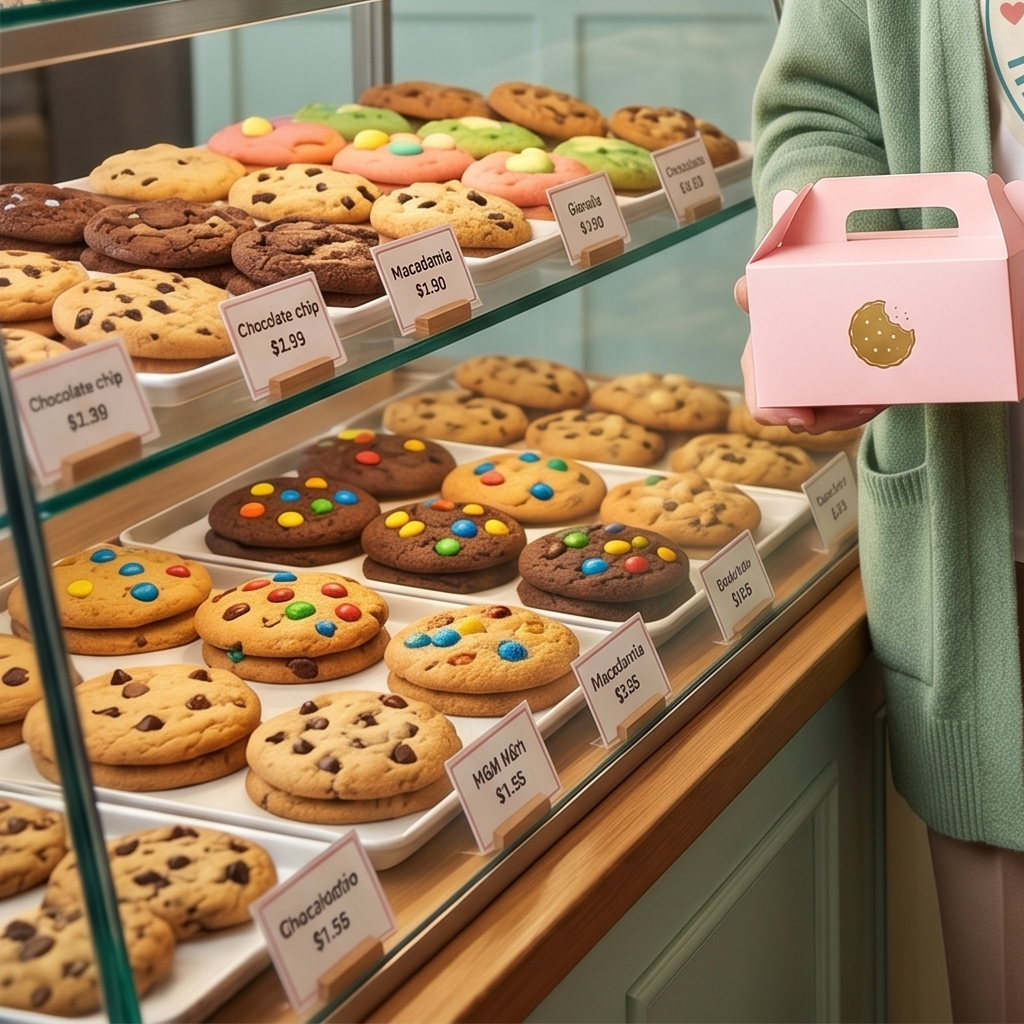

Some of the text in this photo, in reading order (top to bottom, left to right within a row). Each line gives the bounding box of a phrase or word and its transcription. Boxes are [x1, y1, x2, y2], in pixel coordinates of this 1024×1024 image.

[391, 248, 453, 281] Macadamia
[415, 276, 447, 299] $1.90
[295, 300, 320, 318] chip
[29, 370, 123, 413] Chocolate chip
[67, 403, 109, 432] $1.39
